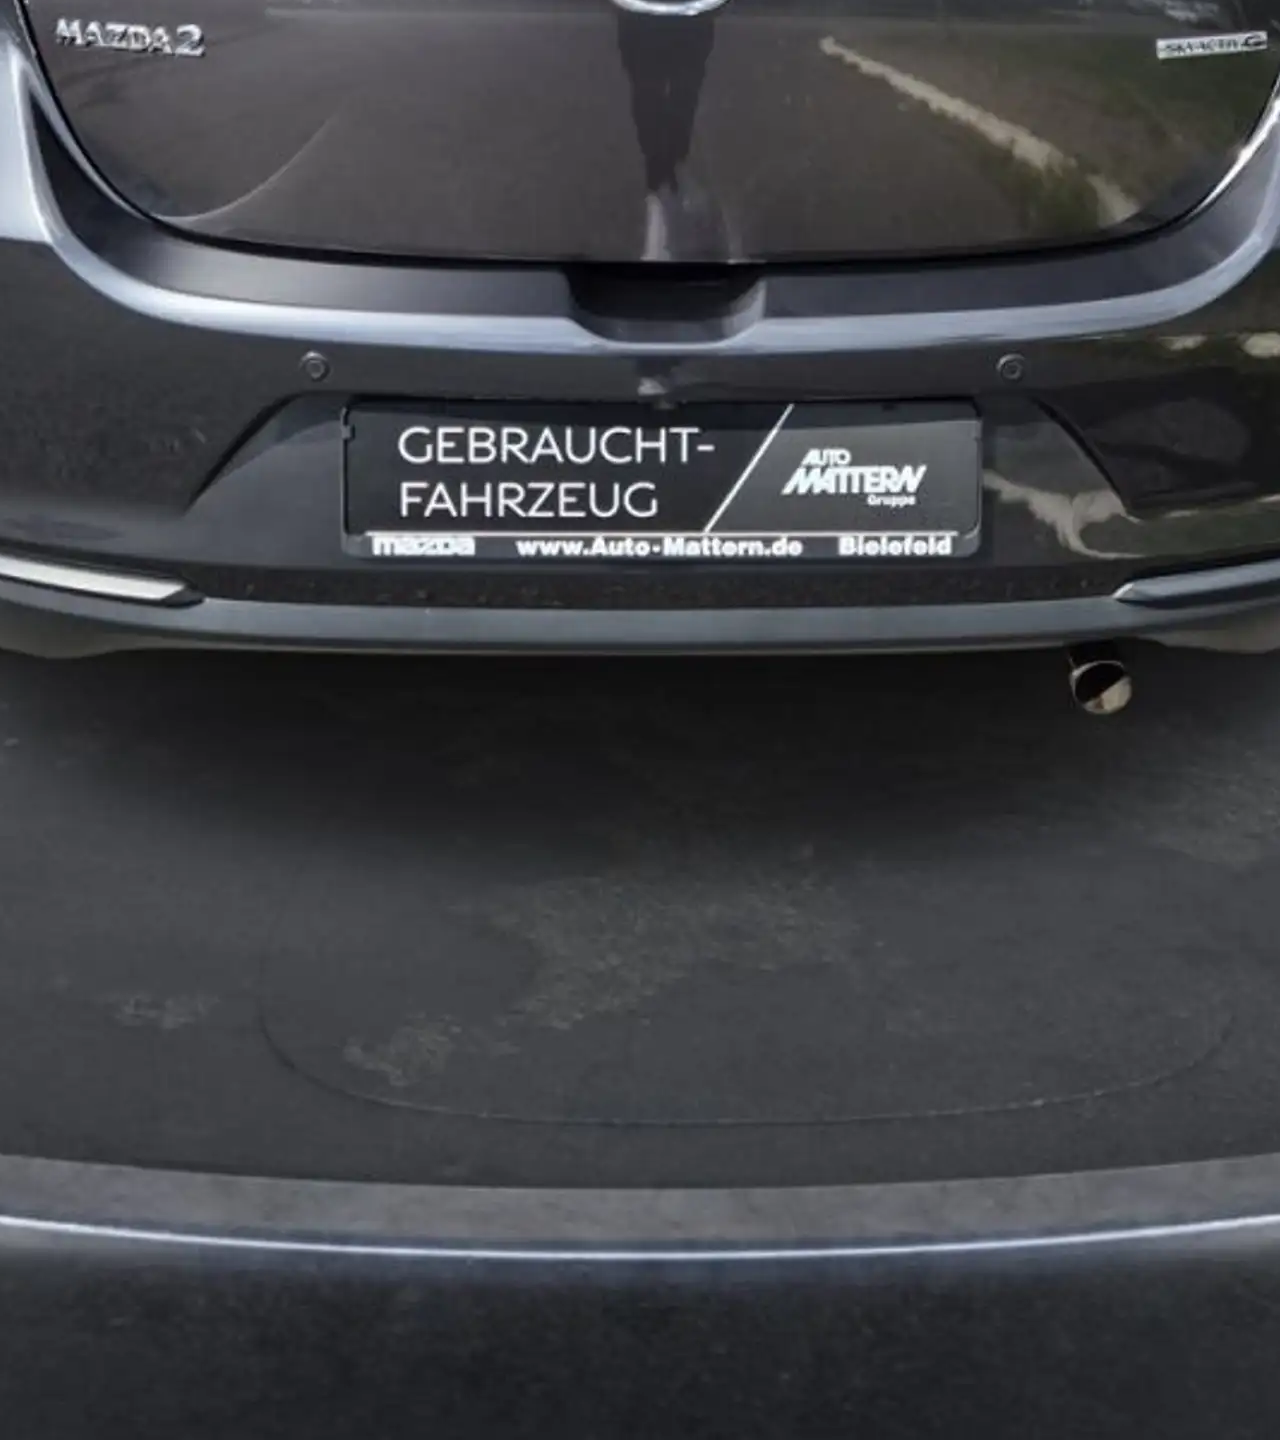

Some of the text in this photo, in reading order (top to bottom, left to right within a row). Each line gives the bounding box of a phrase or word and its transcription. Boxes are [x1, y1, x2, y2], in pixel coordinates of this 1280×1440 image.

[398, 426, 715, 464] GEBRAUCHT-
[801, 448, 852, 466] AUTO
[781, 464, 927, 495] MATTERN
[400, 482, 658, 517] FAHRZEUG
[515, 536, 803, 557] www.Auto-Mattern.de
[837, 536, 952, 556] Bielefeld
